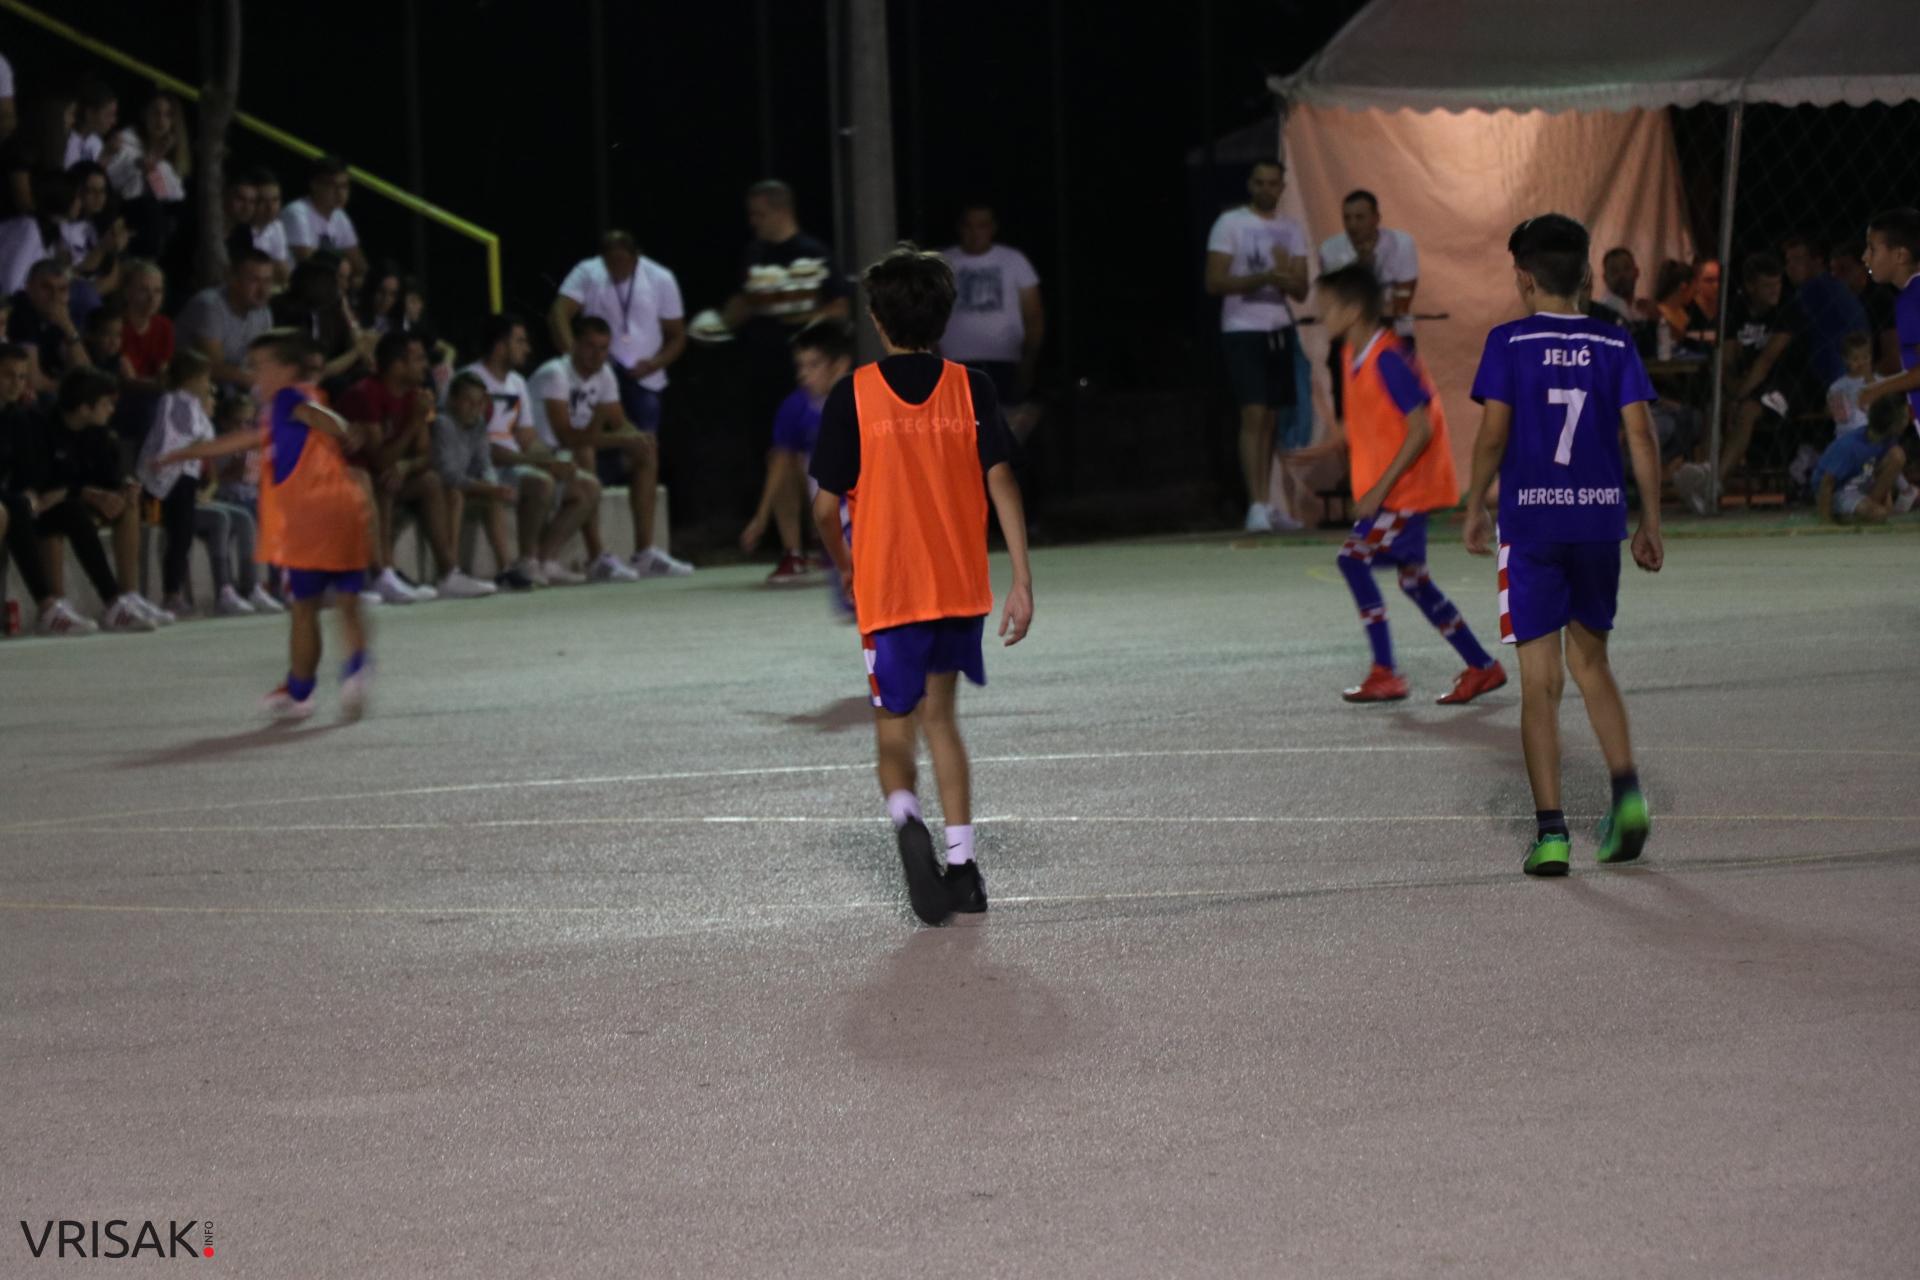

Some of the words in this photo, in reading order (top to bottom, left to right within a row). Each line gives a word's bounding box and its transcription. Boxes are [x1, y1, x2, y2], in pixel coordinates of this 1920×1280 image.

[1542, 345, 1591, 366] JELIĆ
[1547, 388, 1587, 466] 7
[1518, 488, 1574, 505] HERCEG
[1577, 487, 1620, 504] SPORT
